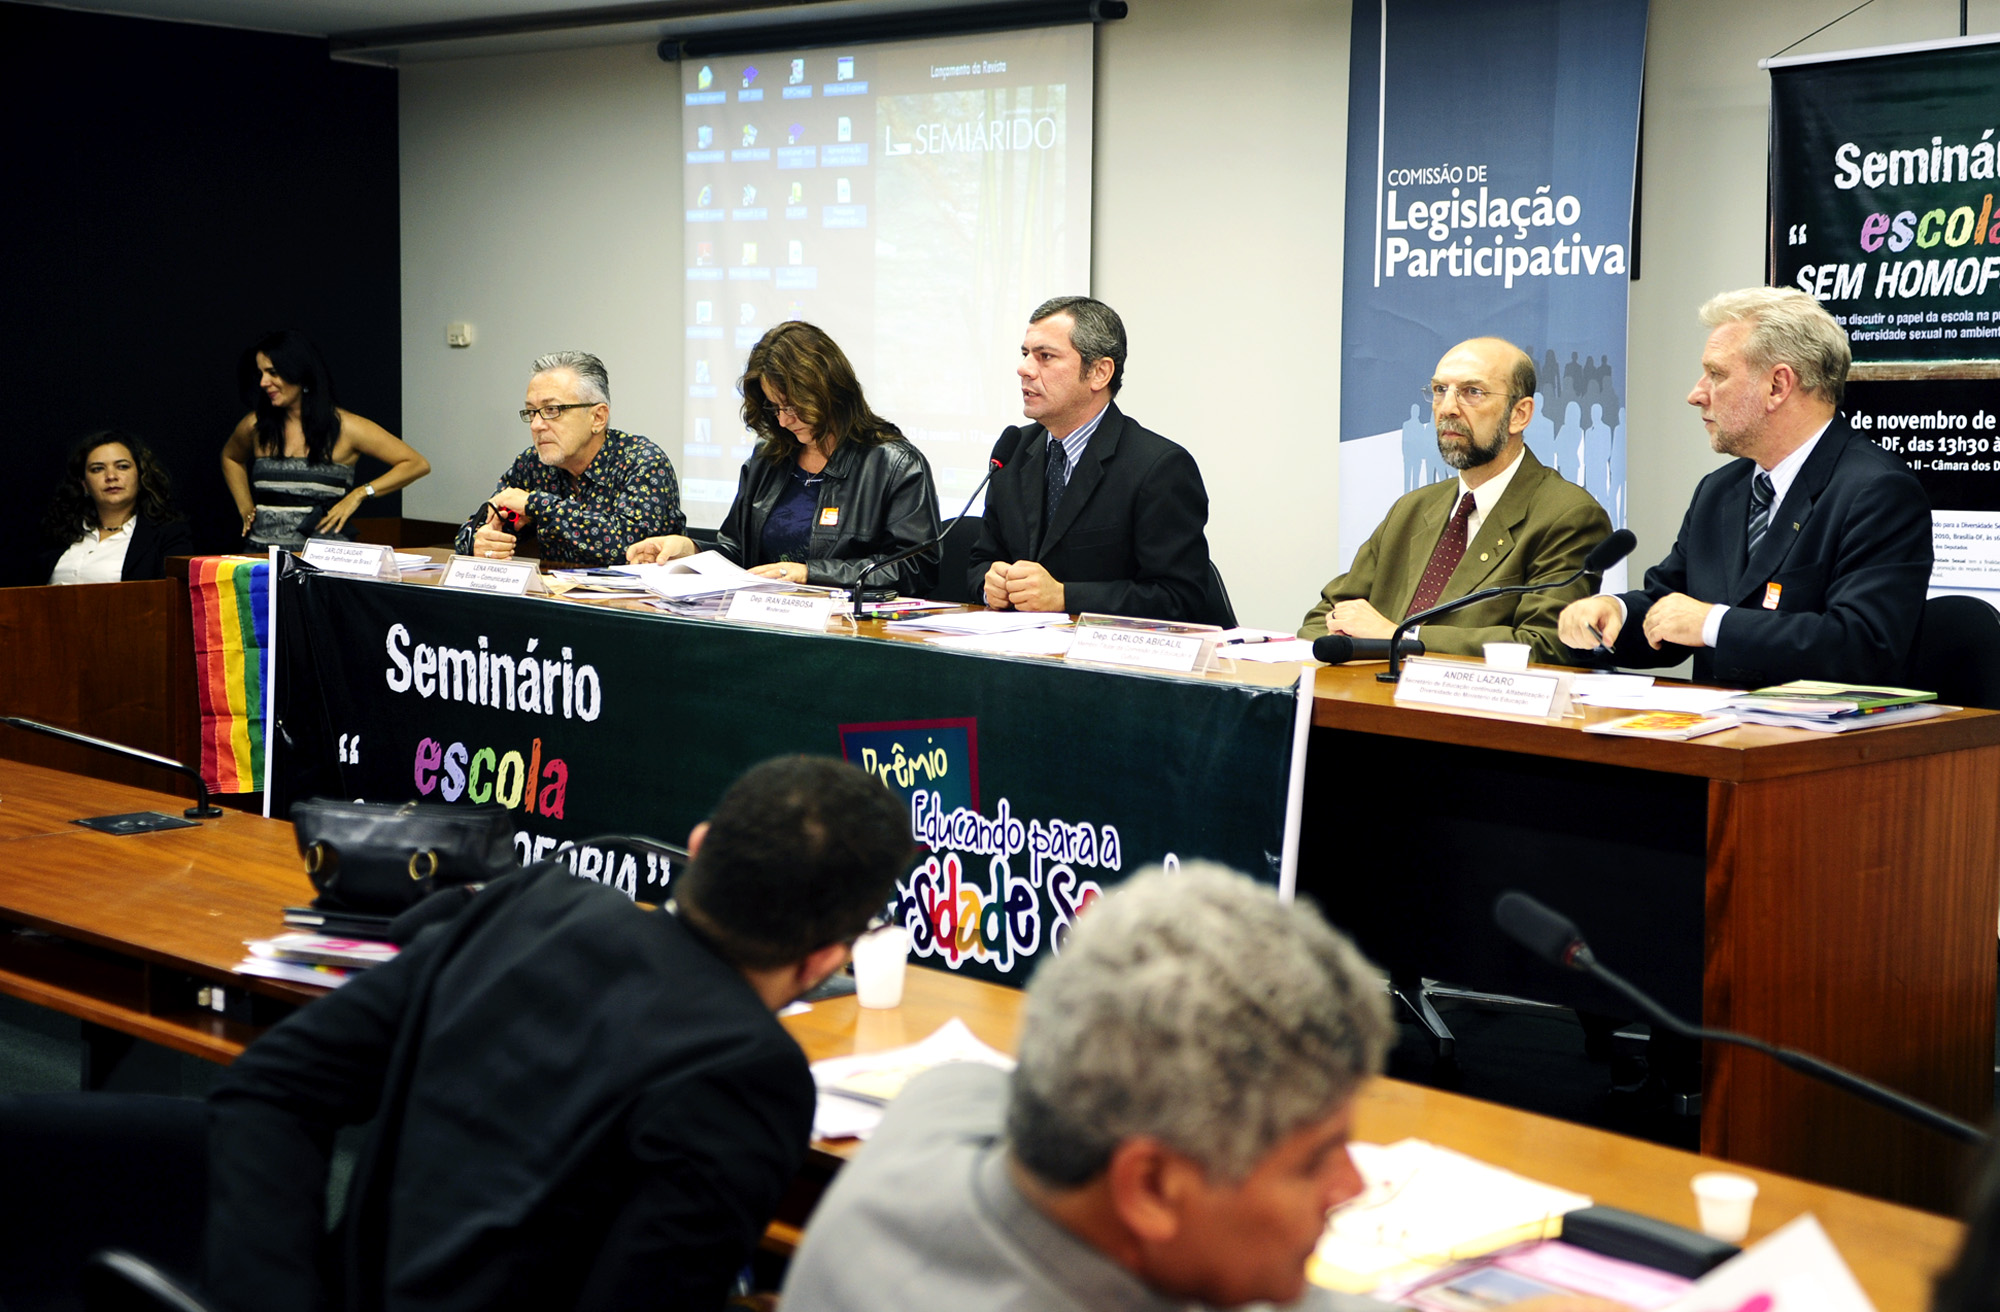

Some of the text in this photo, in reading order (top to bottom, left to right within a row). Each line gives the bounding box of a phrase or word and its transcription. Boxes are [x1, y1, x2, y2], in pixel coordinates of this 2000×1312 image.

[930, 64, 970, 80] Lançamento
[983, 60, 1006, 74] Revista
[915, 112, 1056, 155] SEMIÁRIDO
[1834, 128, 2000, 190] Seminá
[1388, 164, 1487, 186] COMISSÃO DE
[1386, 184, 1581, 242] Legislação
[1385, 232, 1626, 289] Participativa
[1796, 256, 2000, 301] SEM HOMOF
[1849, 312, 1886, 326] discutir
[1888, 314, 1894, 324] o
[1896, 312, 1924, 326] papel
[1926, 311, 1938, 323] da
[1941, 310, 1974, 322] escola
[1976, 312, 1990, 322] na
[1851, 329, 1906, 342] diversidade
[1909, 328, 1942, 340] sexual
[1944, 329, 1958, 339] no
[1850, 410, 1872, 430] de
[1877, 410, 1968, 430] novembro
[1972, 410, 1996, 430] de
[1908, 436, 1934, 452] das
[1938, 436, 1990, 456] 13h30
[1931, 460, 1969, 470] Câmara
[1972, 460, 1990, 470] dos
[324, 546, 343, 554] CARLOS
[481, 574, 511, 583] Comunicação
[487, 566, 508, 574] FRANCO
[470, 581, 497, 589] Sexualidade
[766, 596, 781, 604] IRAN
[781, 598, 814, 608] BARBOSA
[1092, 631, 1182, 649] Dep. CARLOS ABICALIL
[386, 622, 602, 722] Seminário
[1443, 670, 1514, 686] ANDRÉ LÁZARO
[1420, 687, 1452, 696] Diversidade
[1462, 692, 1490, 700] Ministério
[1500, 696, 1528, 705] Educação
[1442, 681, 1470, 691] Educação
[1505, 688, 1545, 699] Alfabetização
[414, 736, 569, 820] escola
[912, 790, 1121, 888] Educando para a
